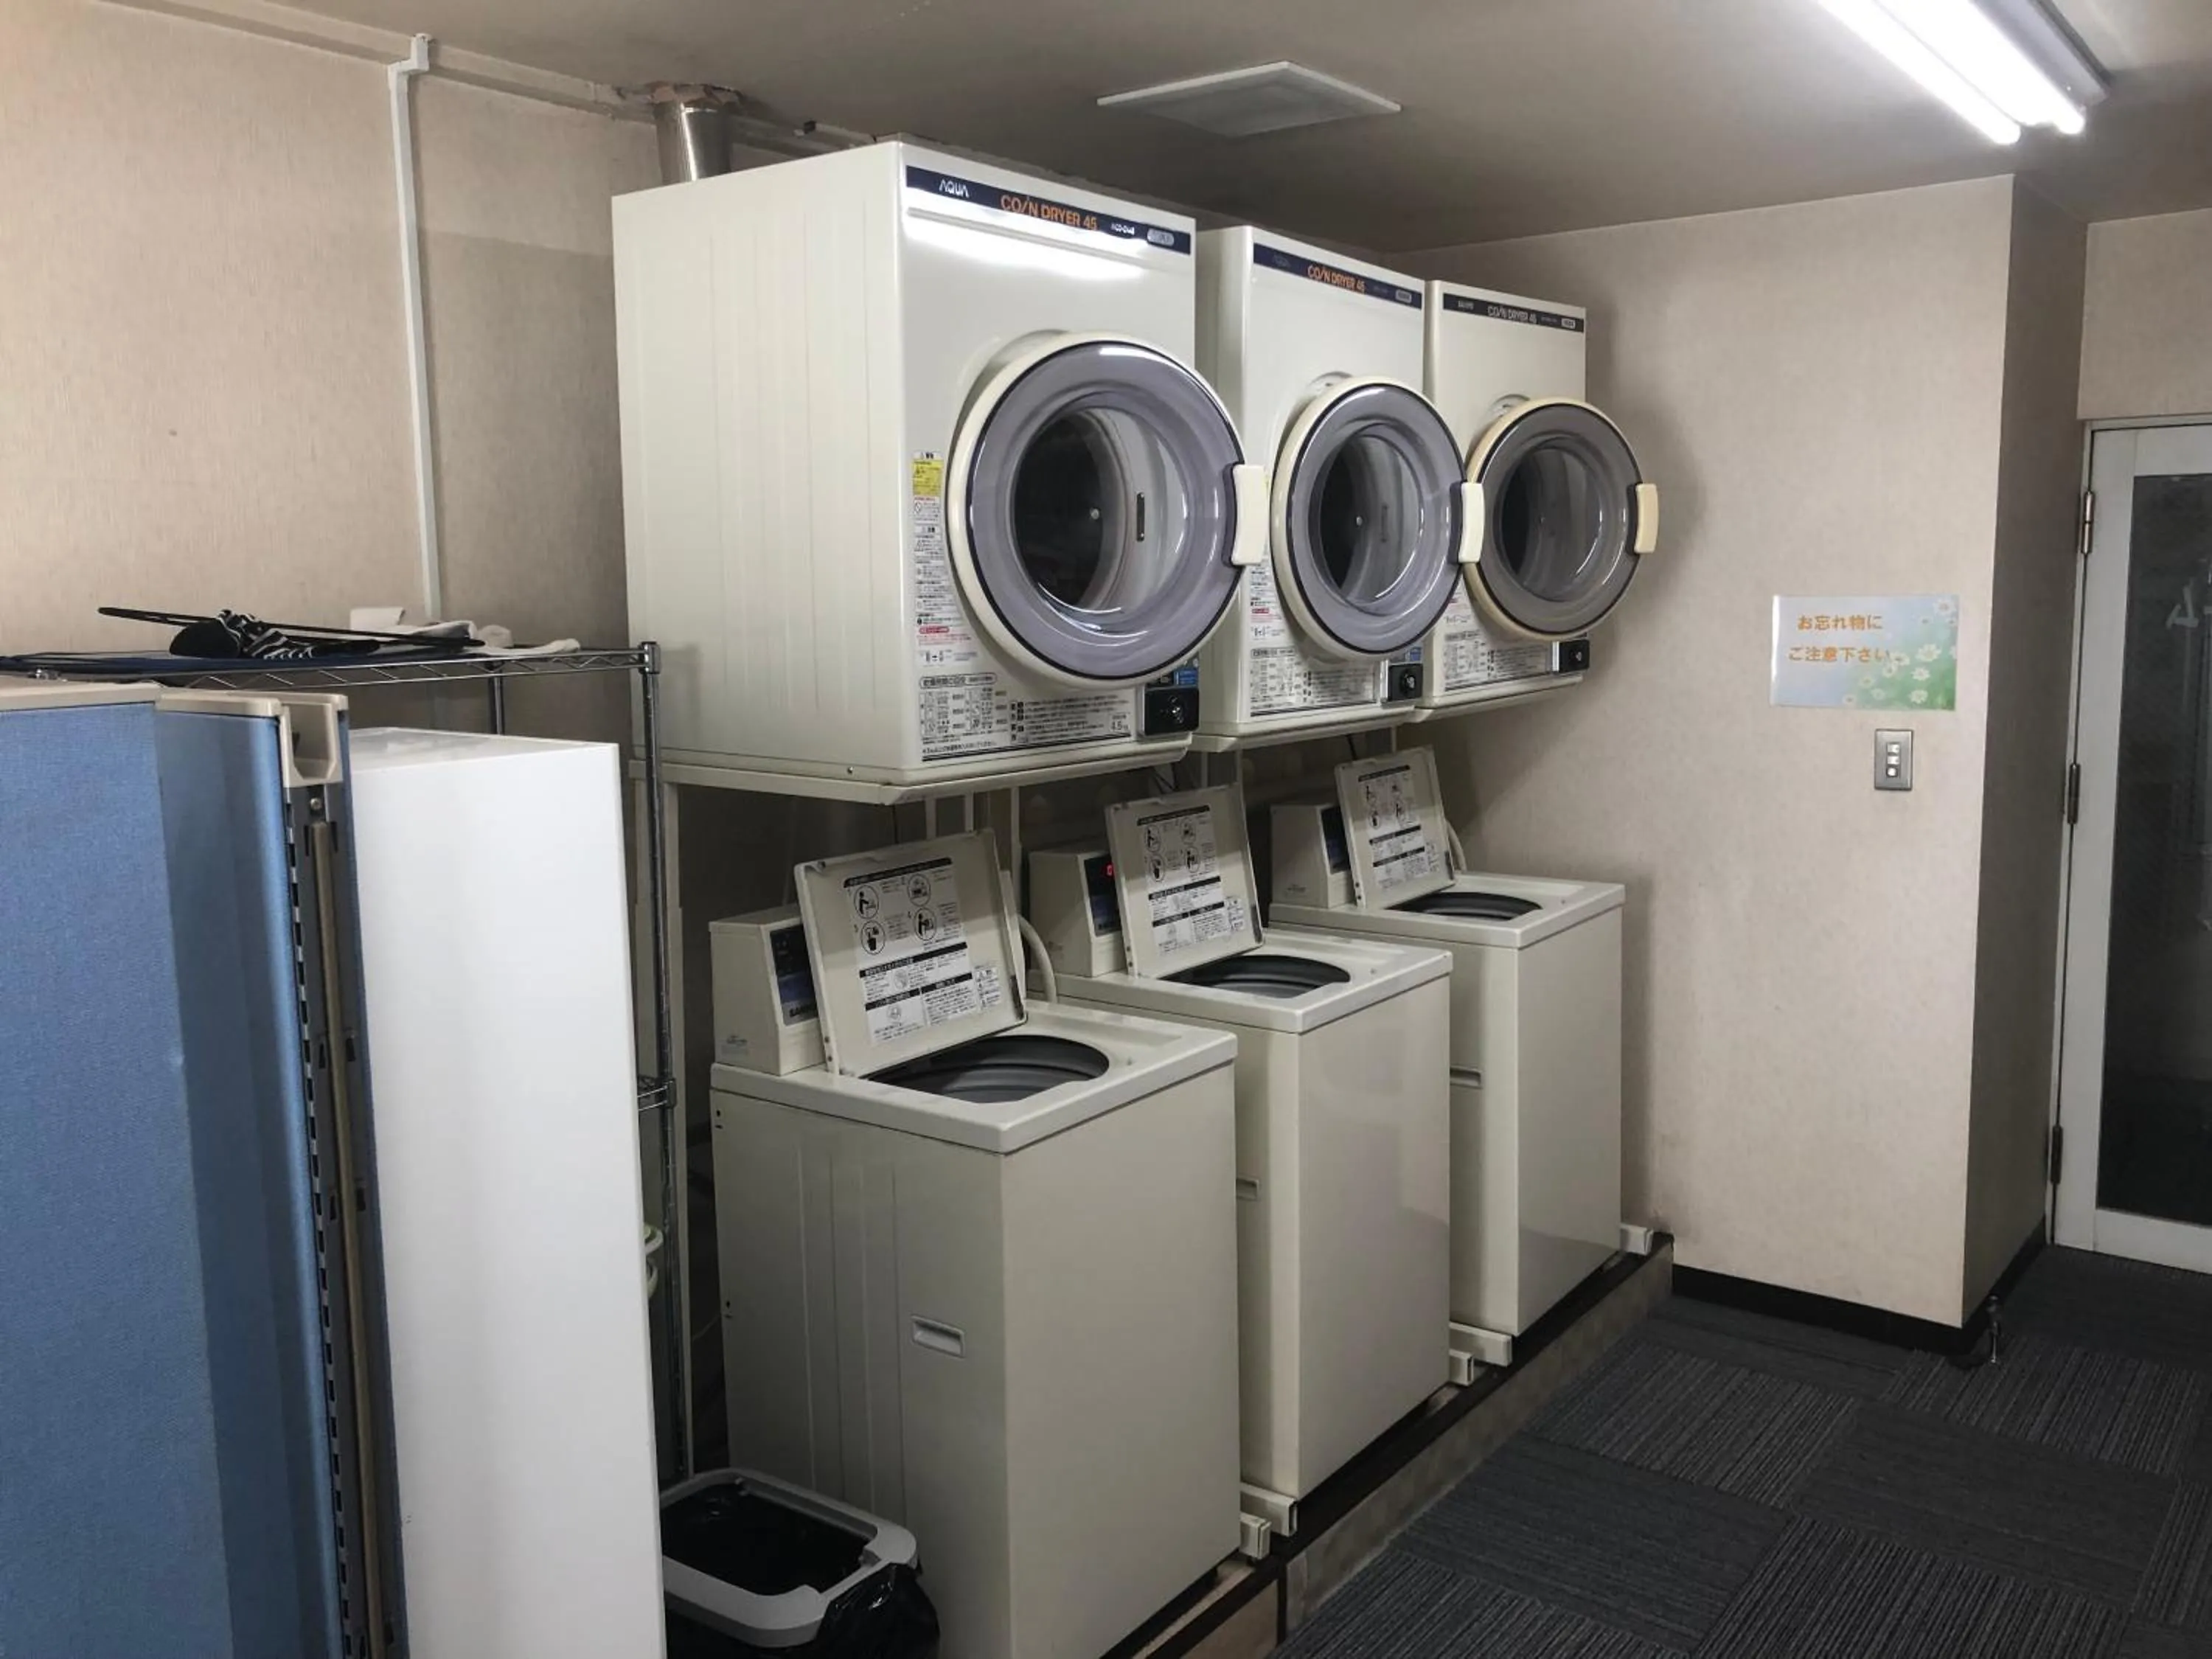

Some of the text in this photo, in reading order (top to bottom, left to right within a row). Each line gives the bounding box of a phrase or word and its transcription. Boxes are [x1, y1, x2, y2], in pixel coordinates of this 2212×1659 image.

[939, 179, 970, 198] AQUA
[1040, 204, 1081, 227] DRYER
[1082, 215, 1098, 230] 45
[1331, 272, 1357, 291] DRYER
[1796, 614, 1884, 631] お忘れ物に
[1787, 645, 1891, 663] ご注意下さい
